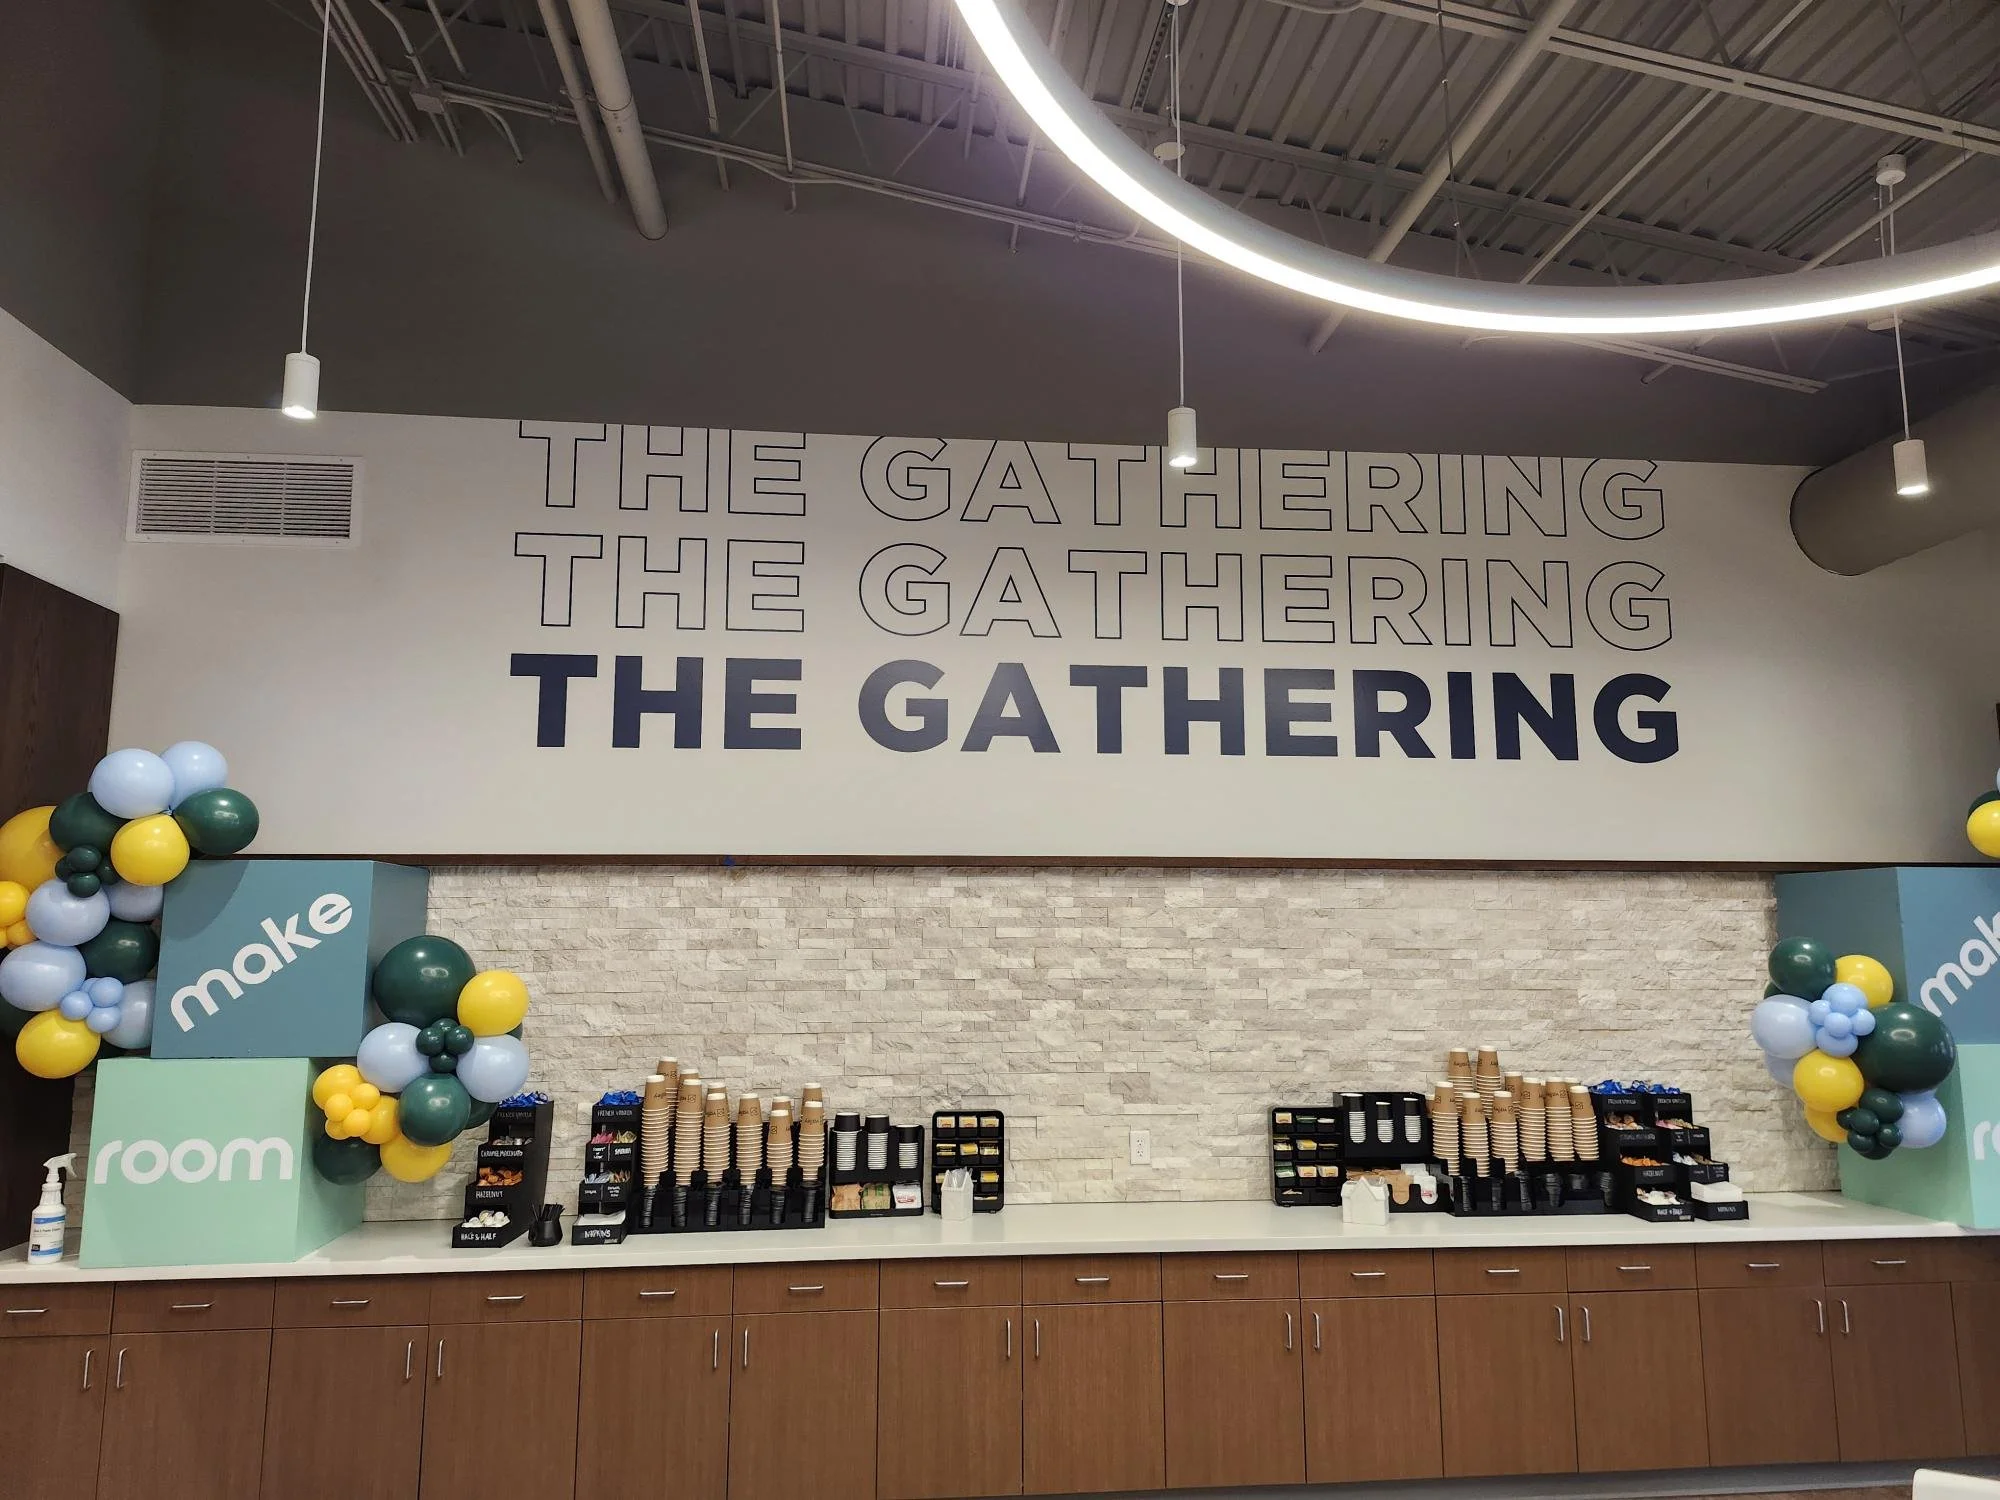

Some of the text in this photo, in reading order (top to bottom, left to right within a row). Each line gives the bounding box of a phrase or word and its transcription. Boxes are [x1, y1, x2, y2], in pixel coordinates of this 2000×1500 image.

[519, 420, 1665, 540] THE GATHERING
[515, 532, 1672, 651] THE GATHERING
[510, 653, 1679, 763] THE GATHERING
[170, 893, 353, 1032] make
[94, 1137, 293, 1185] room
